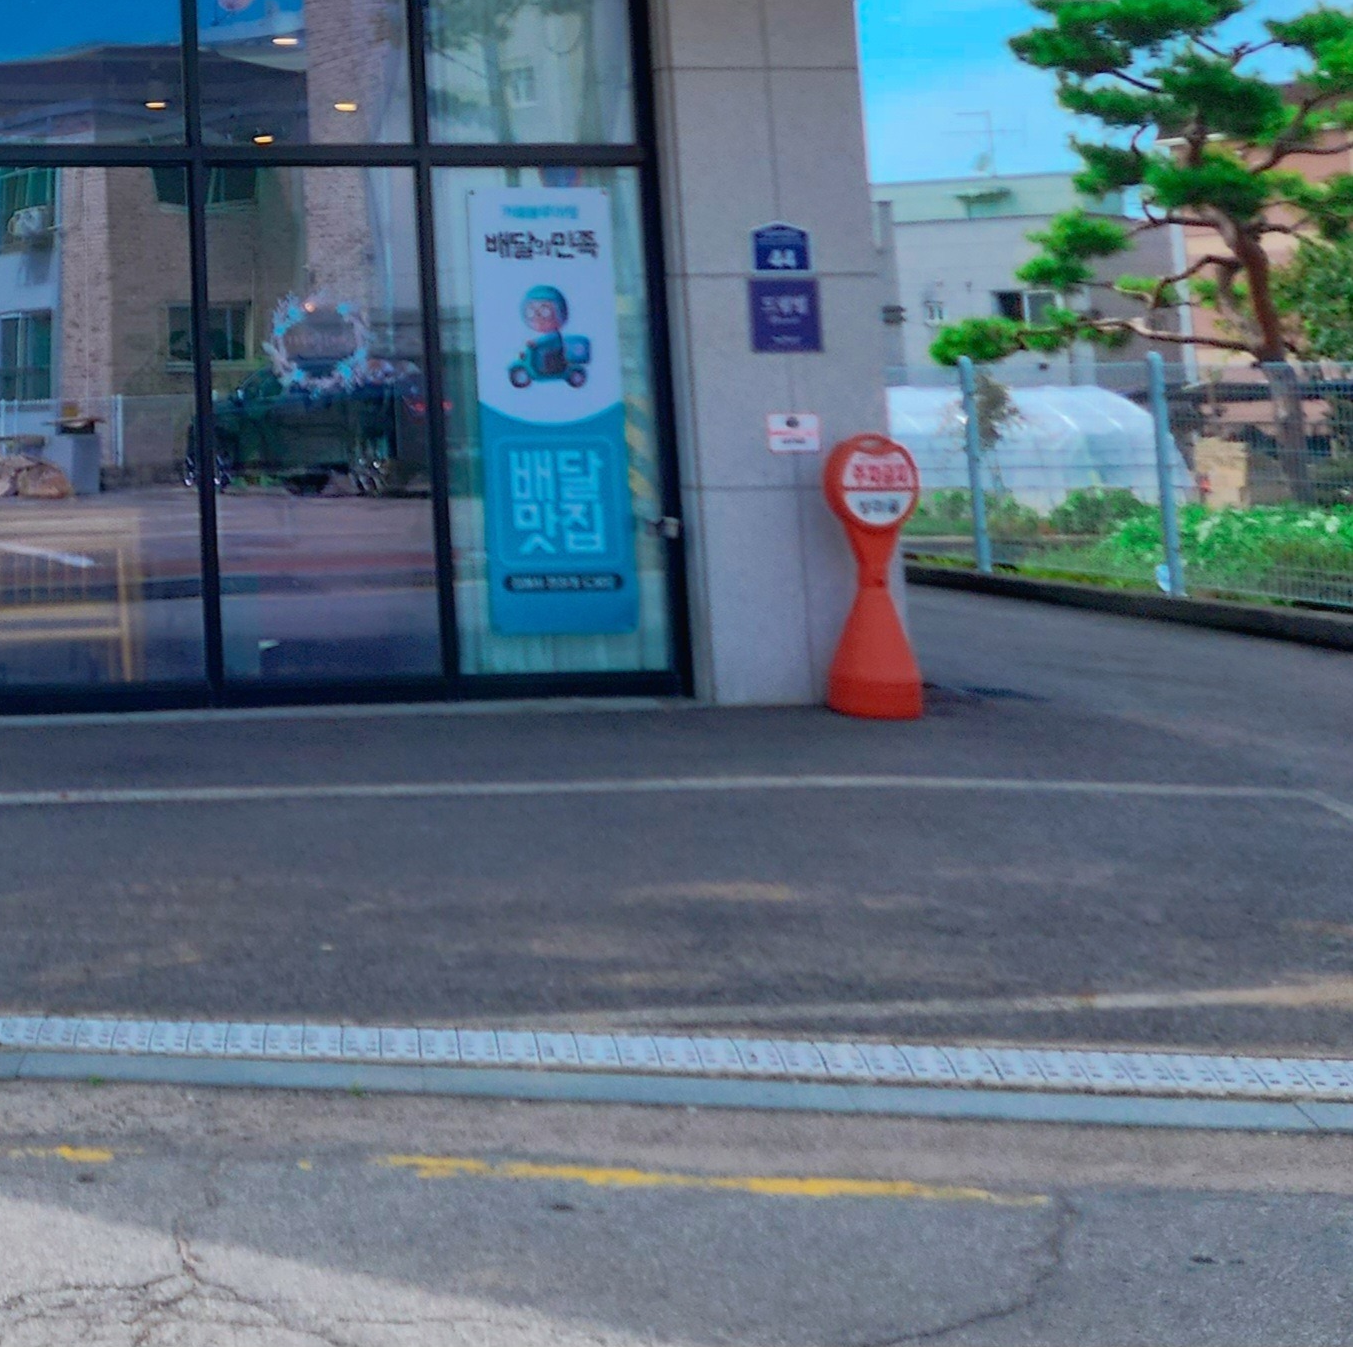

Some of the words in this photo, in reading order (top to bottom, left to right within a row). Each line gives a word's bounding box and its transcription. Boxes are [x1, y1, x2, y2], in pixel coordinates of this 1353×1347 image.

[484, 229, 599, 259] 배달의민족
[508, 449, 604, 501] 배달
[513, 502, 607, 555] 맛집
